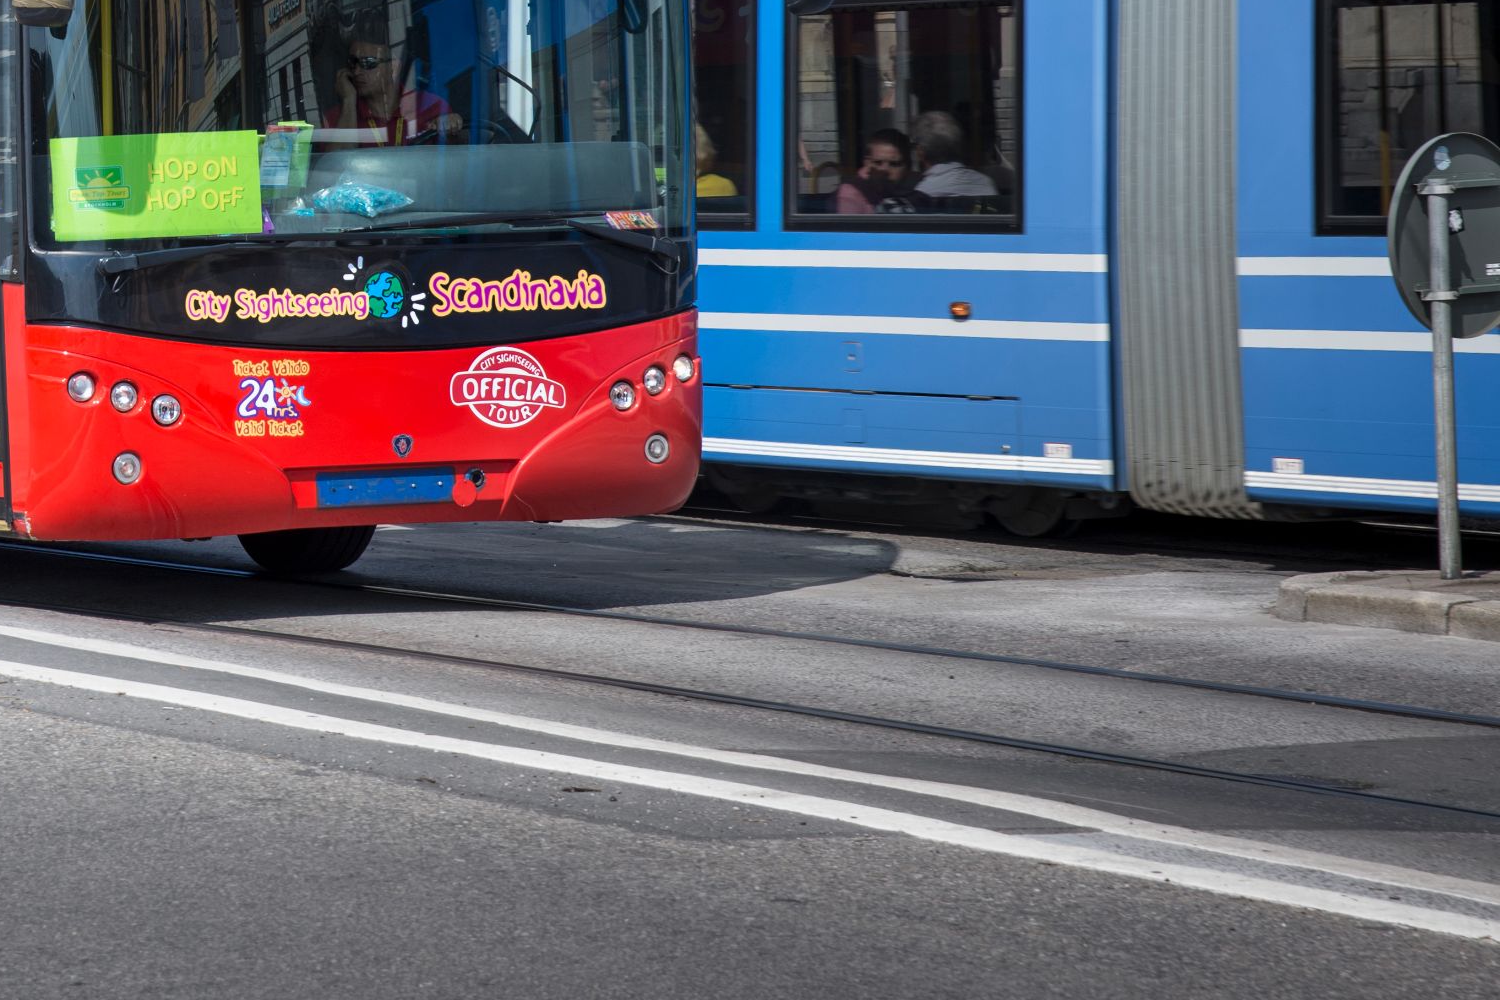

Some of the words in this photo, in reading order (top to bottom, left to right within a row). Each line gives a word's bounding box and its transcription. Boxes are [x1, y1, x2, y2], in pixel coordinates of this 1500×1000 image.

[147, 156, 198, 183] HOP
[202, 154, 238, 181] ON
[146, 185, 197, 212] HOP
[201, 185, 245, 212] OFF
[186, 289, 231, 323] City
[236, 287, 369, 323] Sightseeing
[429, 269, 607, 317] Scandinavia
[233, 359, 270, 376] Ticket
[480, 356, 496, 371] CITY
[496, 352, 541, 377] SIGHTSEEING
[462, 377, 559, 405] OFFICIAL
[488, 404, 533, 423] TOUR
[235, 420, 265, 437] Valid
[268, 419, 304, 436] Ticket
